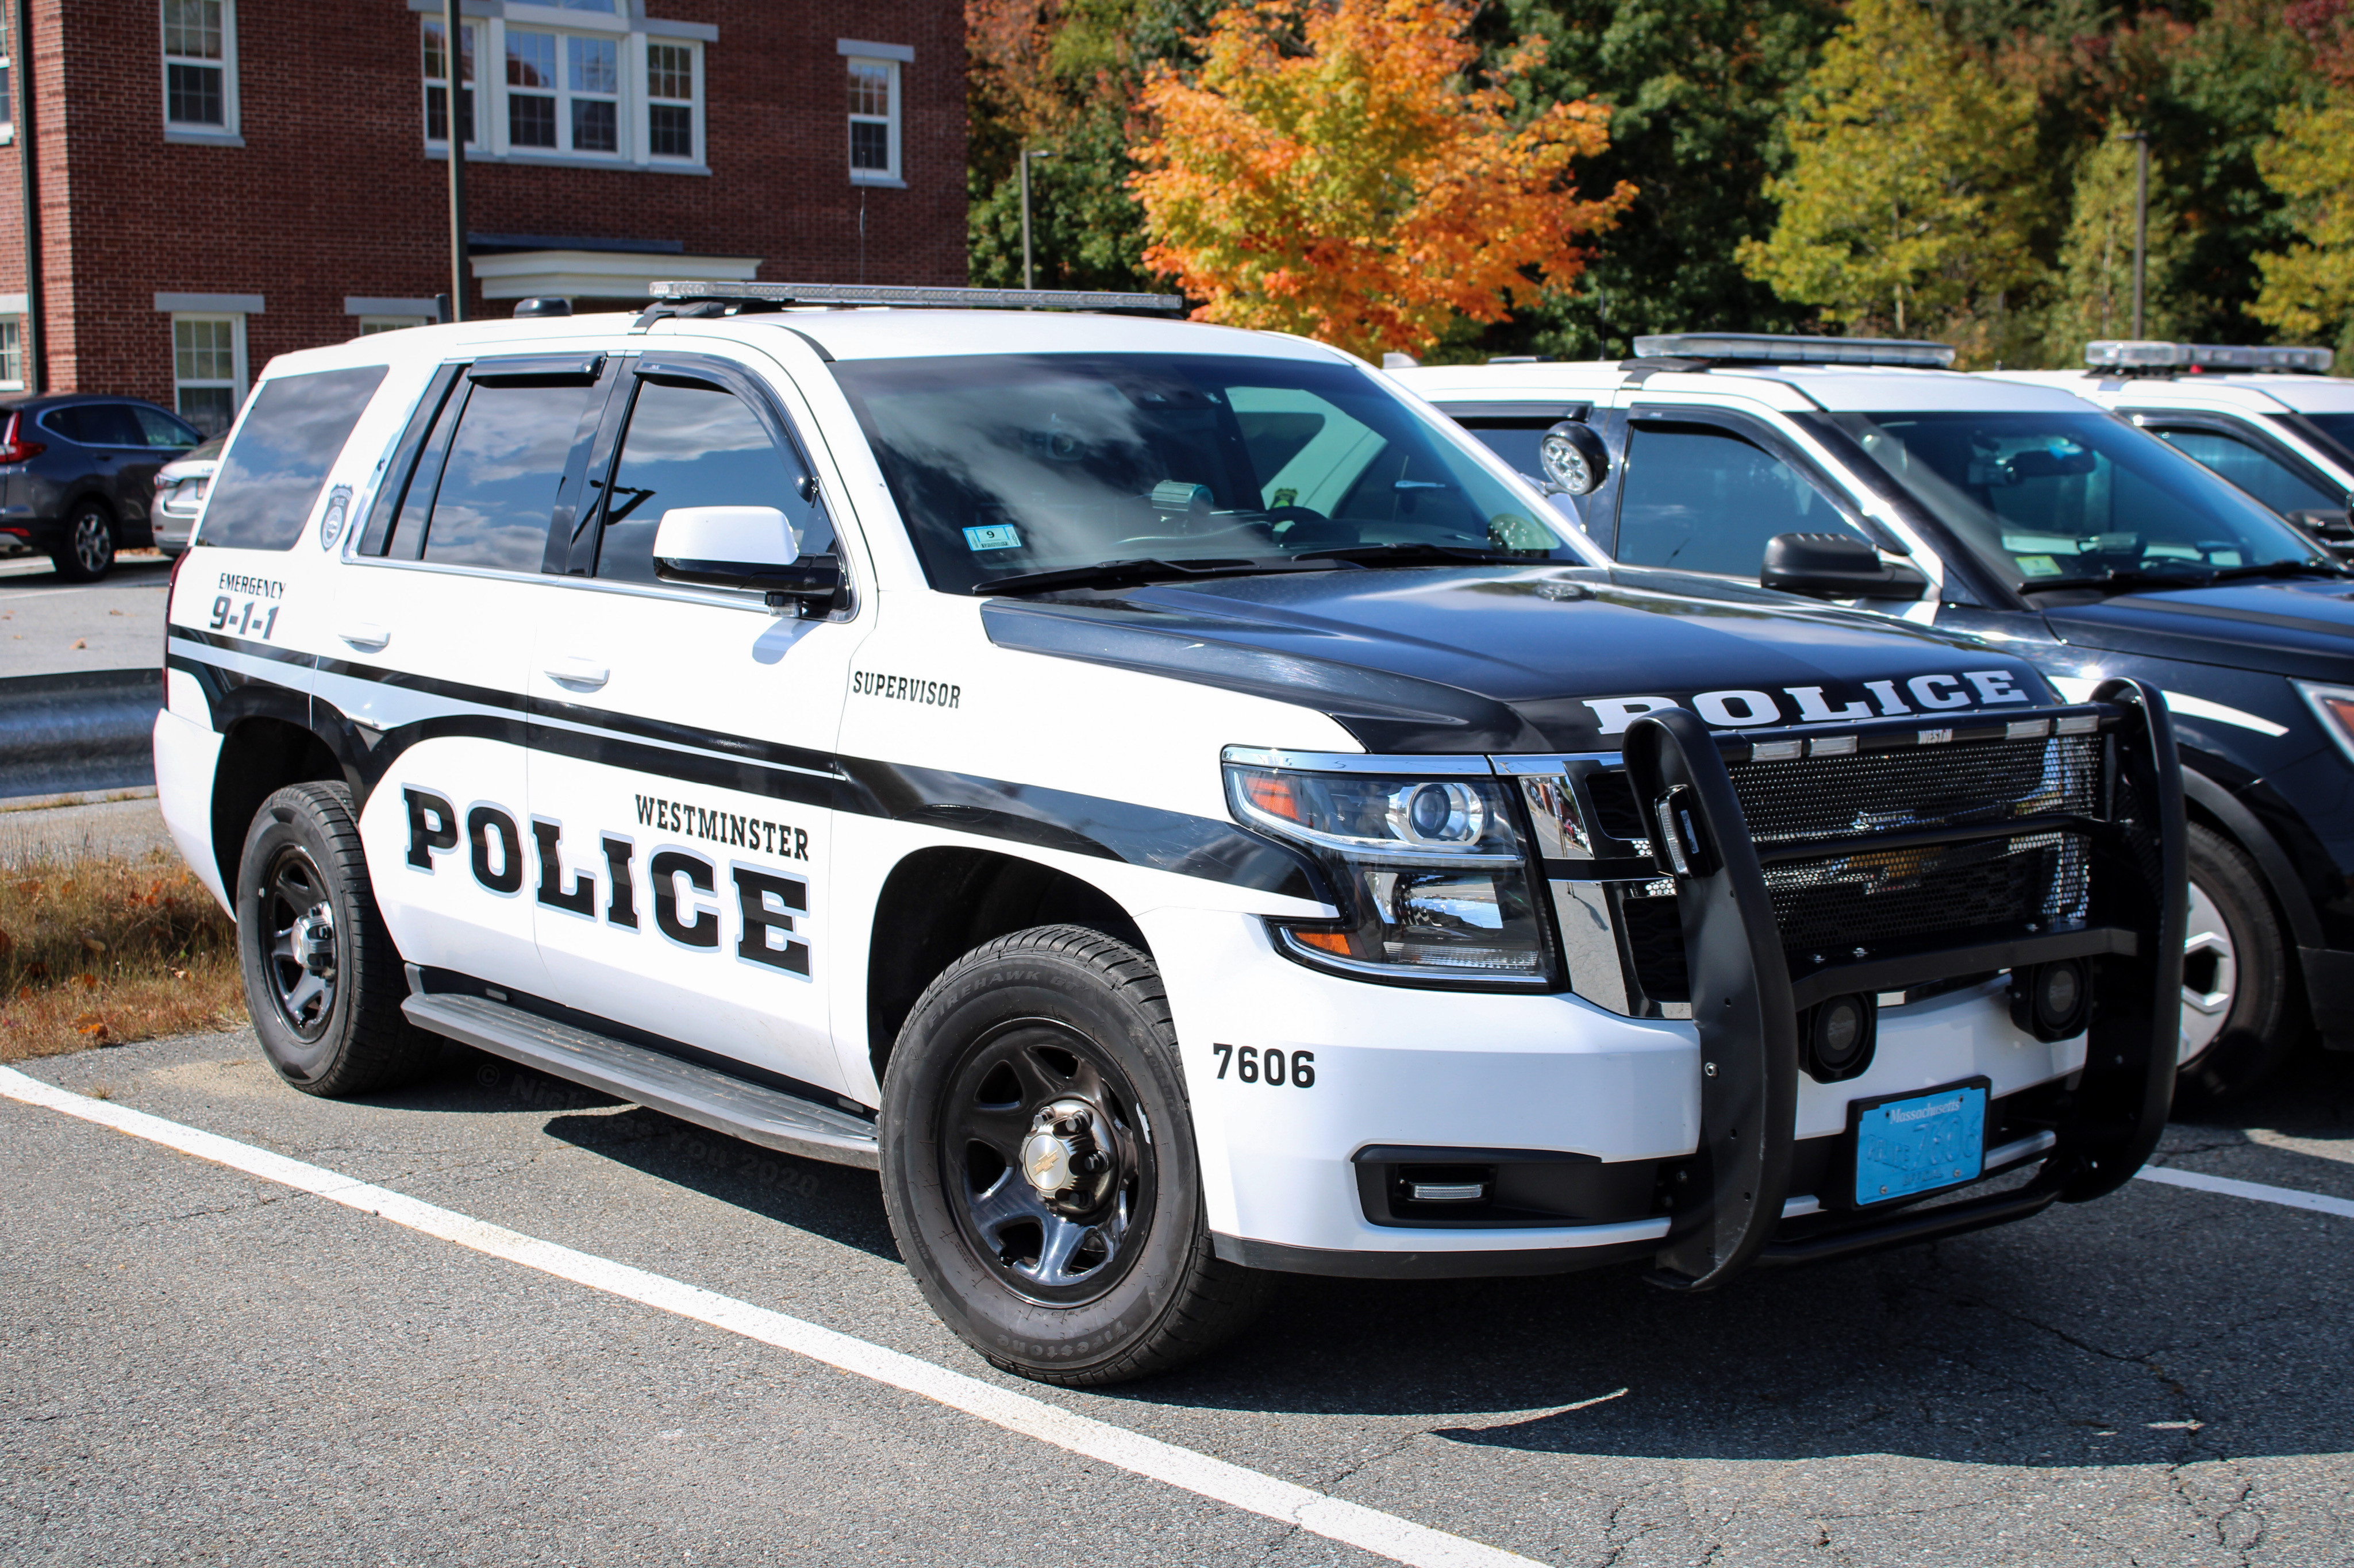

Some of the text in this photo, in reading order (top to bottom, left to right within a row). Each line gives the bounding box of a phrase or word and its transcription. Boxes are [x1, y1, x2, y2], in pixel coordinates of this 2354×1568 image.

[986, 530, 995, 538] 9
[218, 572, 286, 600] EMERGENCY
[209, 594, 280, 641] 9-1-1
[853, 670, 961, 709] SUPERVISOR
[1581, 669, 2030, 735] POLICE
[635, 793, 809, 862] WESTMINSTER
[400, 781, 814, 984] POLICE
[928, 970, 1042, 1030] FIREHAWK
[1213, 1042, 1316, 1089] 7606
[1889, 1100, 1961, 1124] Massachusetts
[1910, 1110, 1981, 1171] 7606
